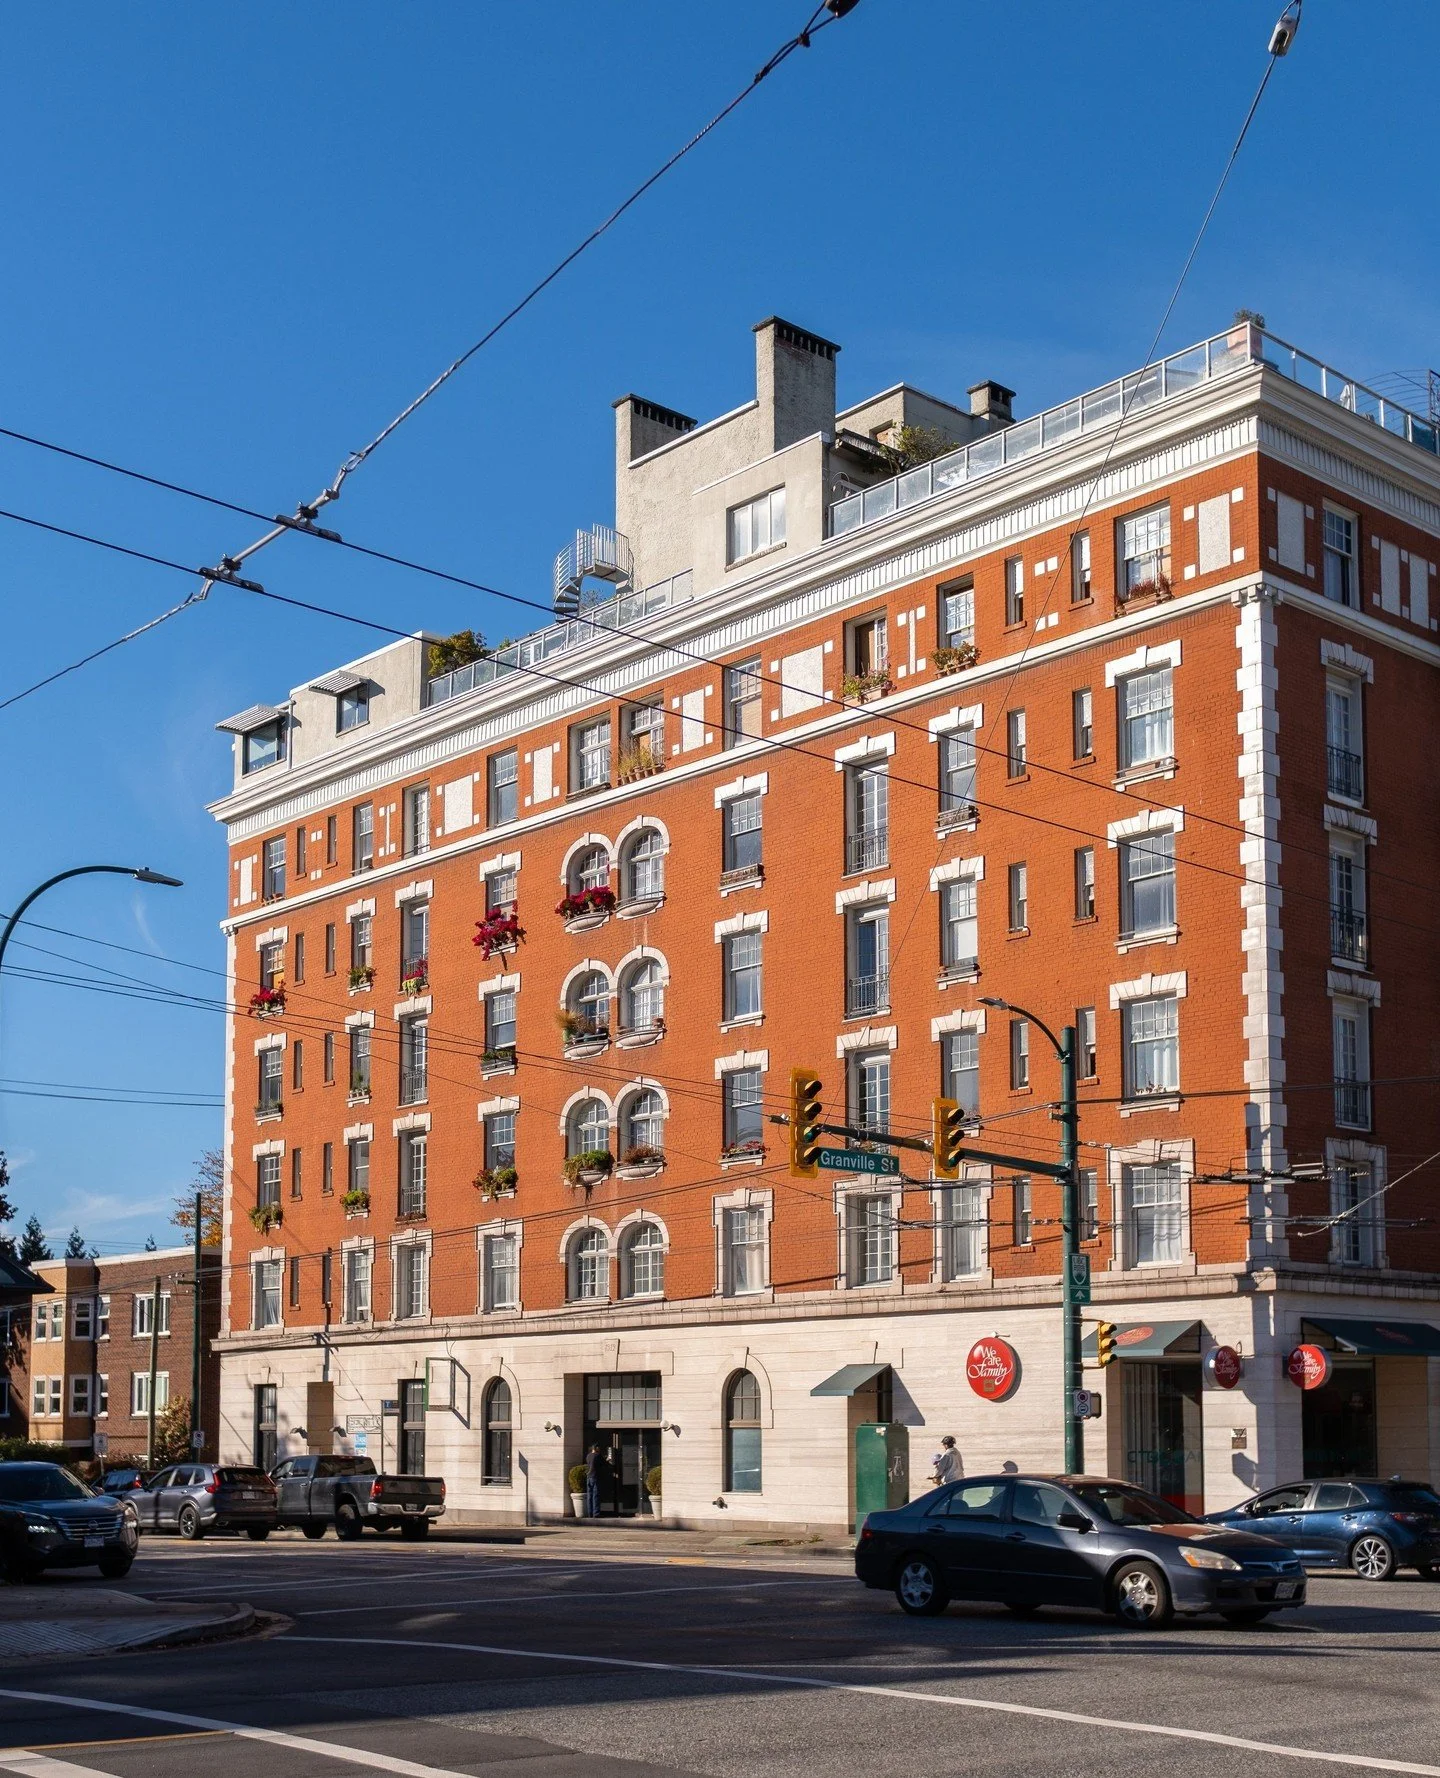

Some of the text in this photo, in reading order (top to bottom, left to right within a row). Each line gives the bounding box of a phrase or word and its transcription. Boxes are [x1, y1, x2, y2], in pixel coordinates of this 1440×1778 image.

[821, 1151, 897, 1172] Granville St
[980, 1346, 996, 1358] We
[987, 1356, 1001, 1366] are
[968, 1358, 1013, 1385] Family
[1288, 1360, 1325, 1379] Family
